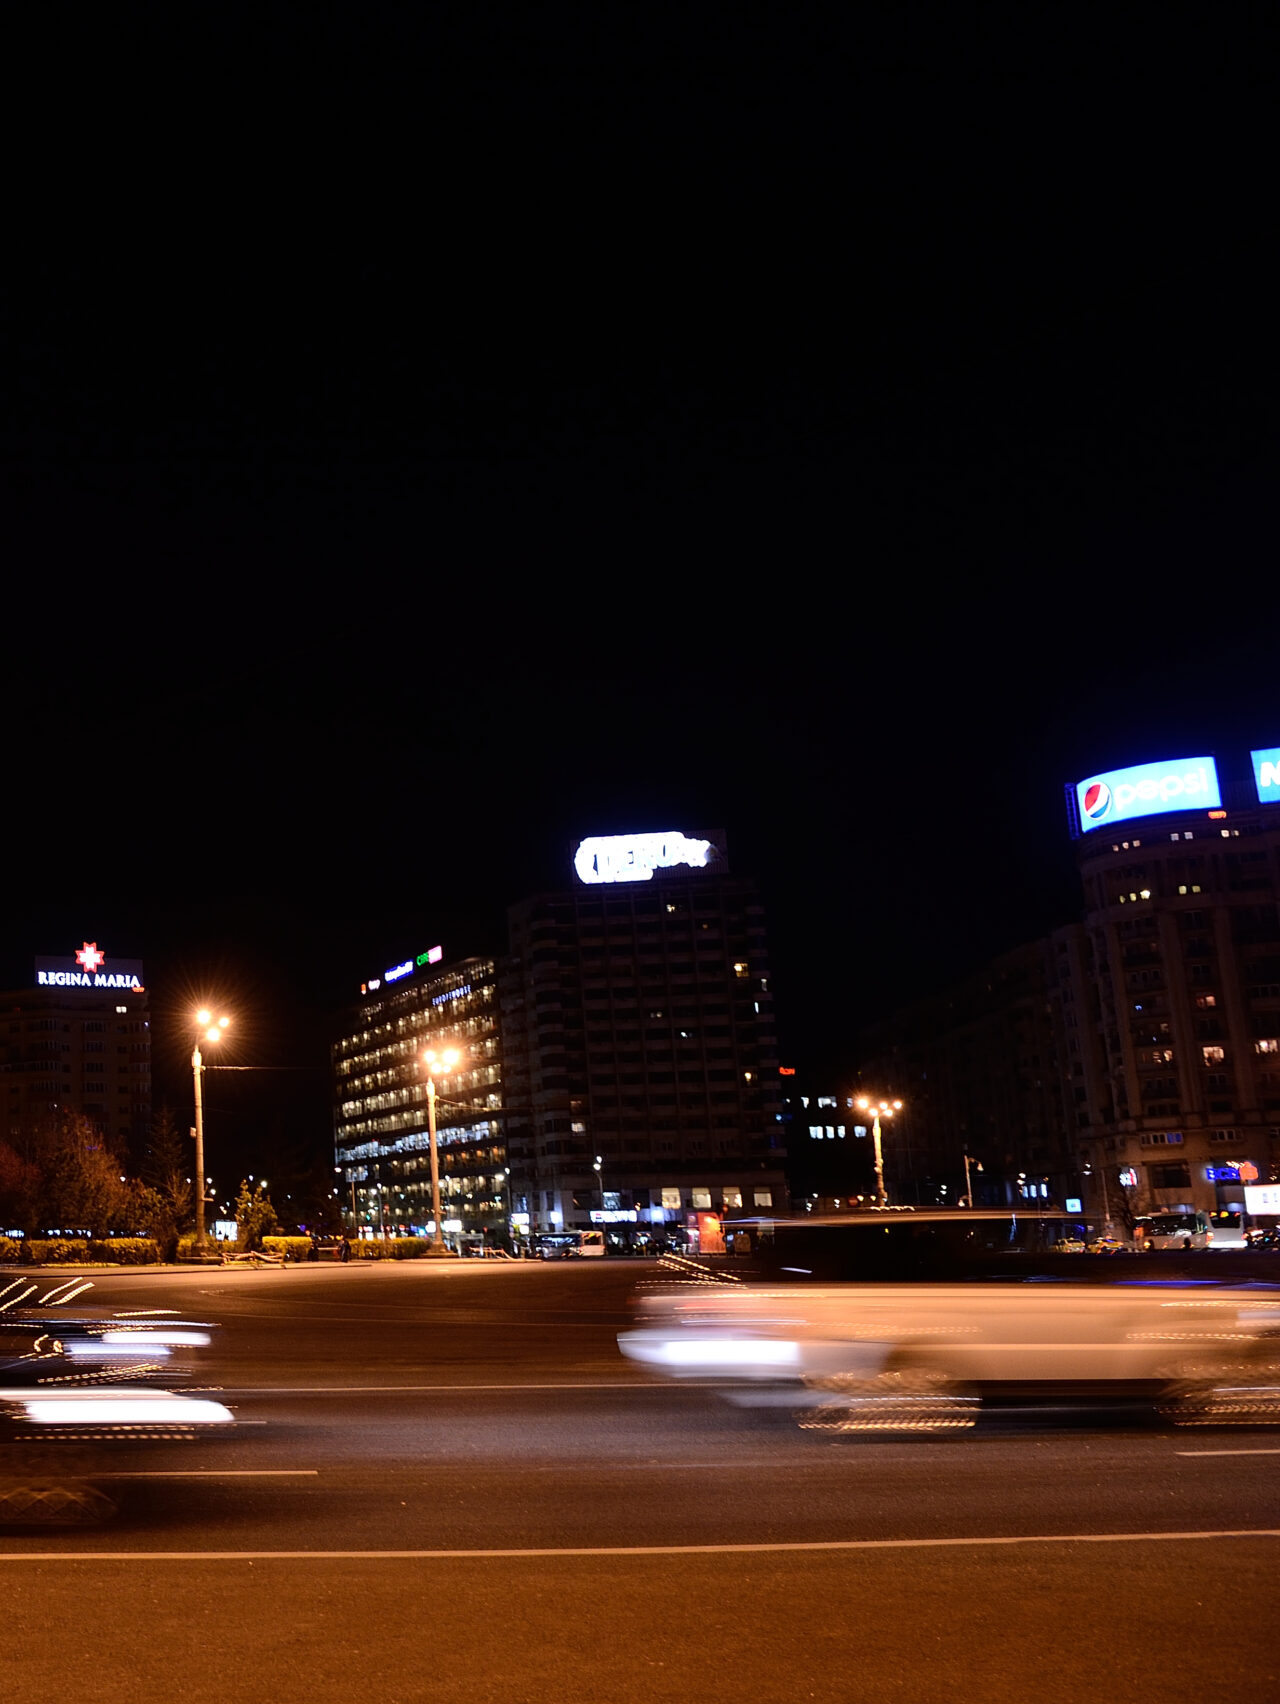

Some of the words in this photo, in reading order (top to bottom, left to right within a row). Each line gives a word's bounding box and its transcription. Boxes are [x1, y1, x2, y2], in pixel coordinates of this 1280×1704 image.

[1113, 767, 1209, 811] pepsi
[38, 971, 92, 987] REGINA
[94, 974, 141, 988] MARIA
